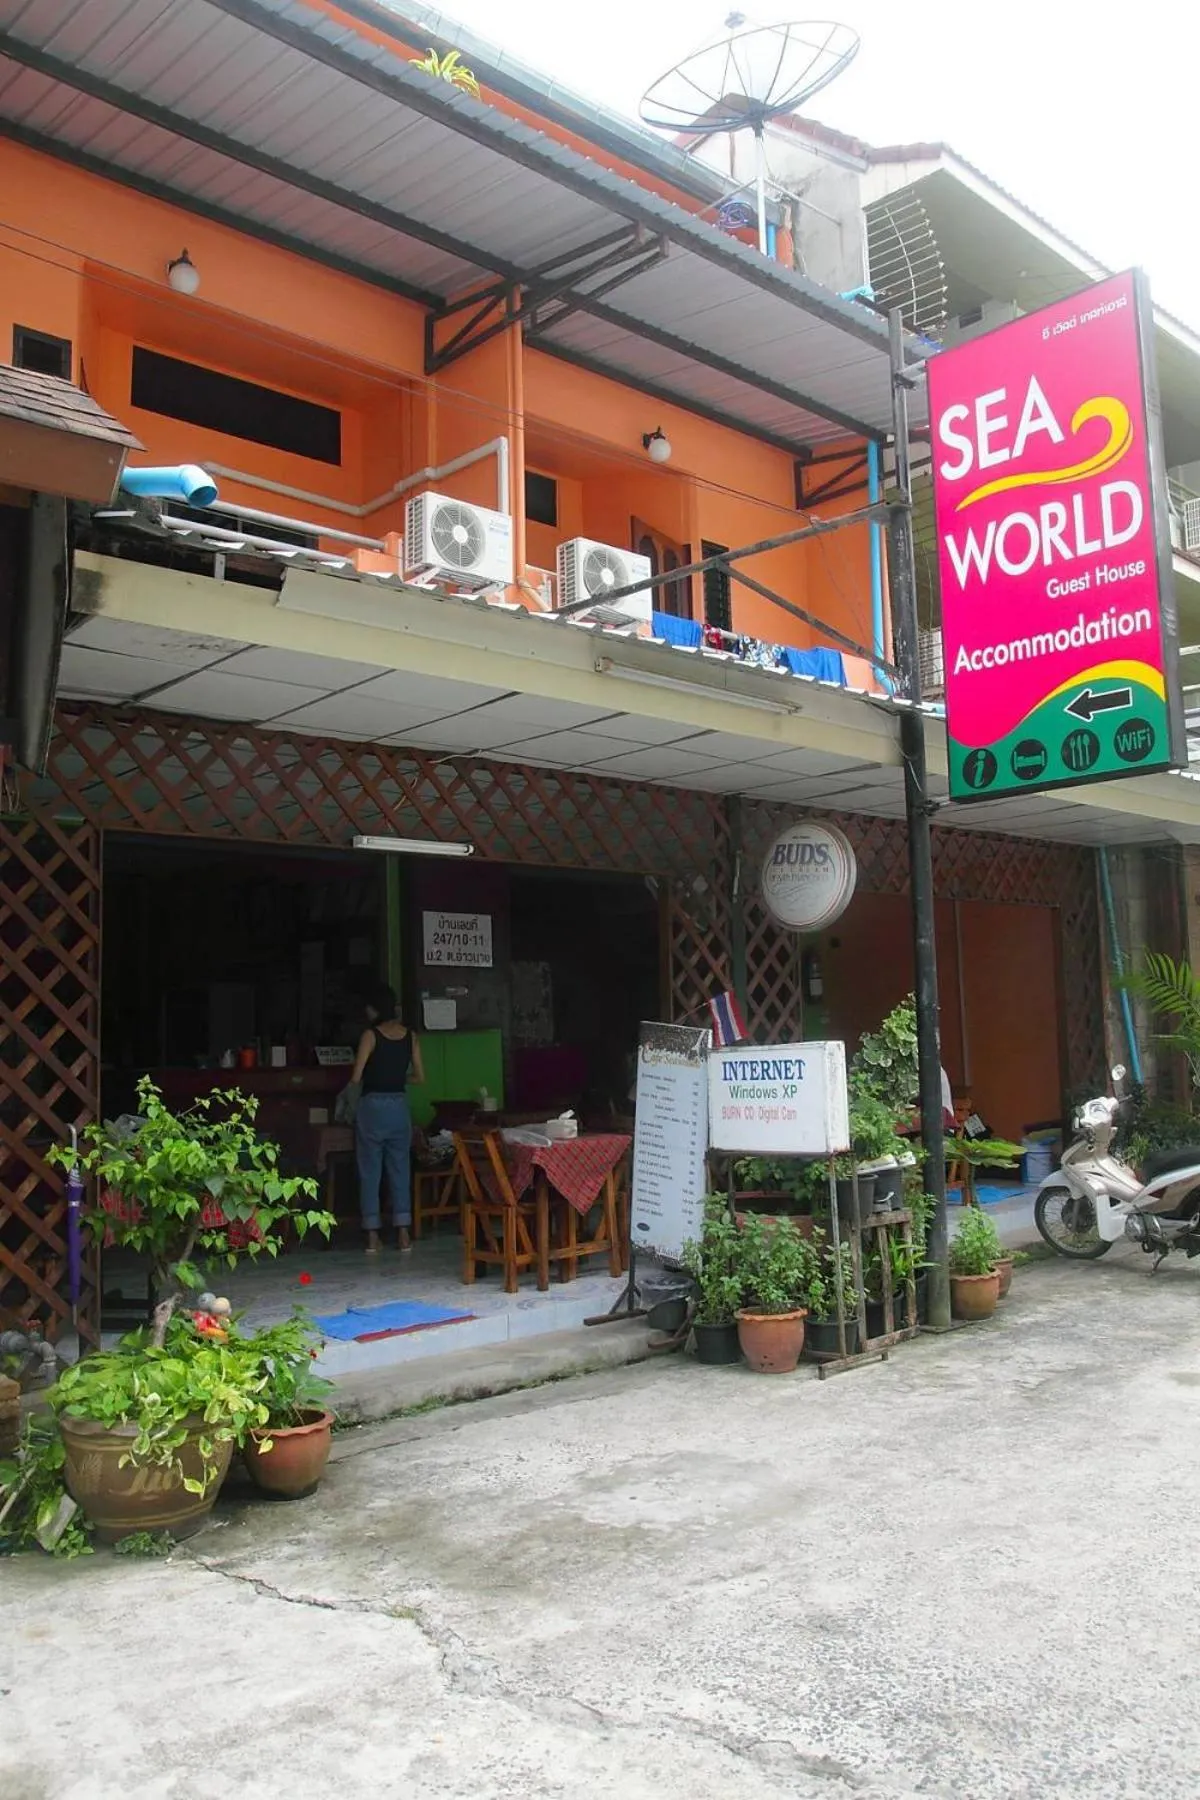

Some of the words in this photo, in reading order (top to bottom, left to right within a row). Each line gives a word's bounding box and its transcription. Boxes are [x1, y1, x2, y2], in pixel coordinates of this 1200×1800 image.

[939, 374, 1065, 481] SEA
[944, 480, 1143, 591] WORLD
[1046, 572, 1090, 598] Guest
[1095, 560, 1146, 586] House
[953, 606, 1152, 675] Accommodation
[1116, 728, 1152, 753] WiFi
[722, 1059, 806, 1081] INTERNET
[729, 1085, 778, 1099] Windows
[782, 1084, 798, 1099] XP
[722, 1106, 741, 1120] BURN
[744, 1105, 755, 1120] CD
[759, 1105, 779, 1124] Digital
[782, 1106, 797, 1120] Cam
